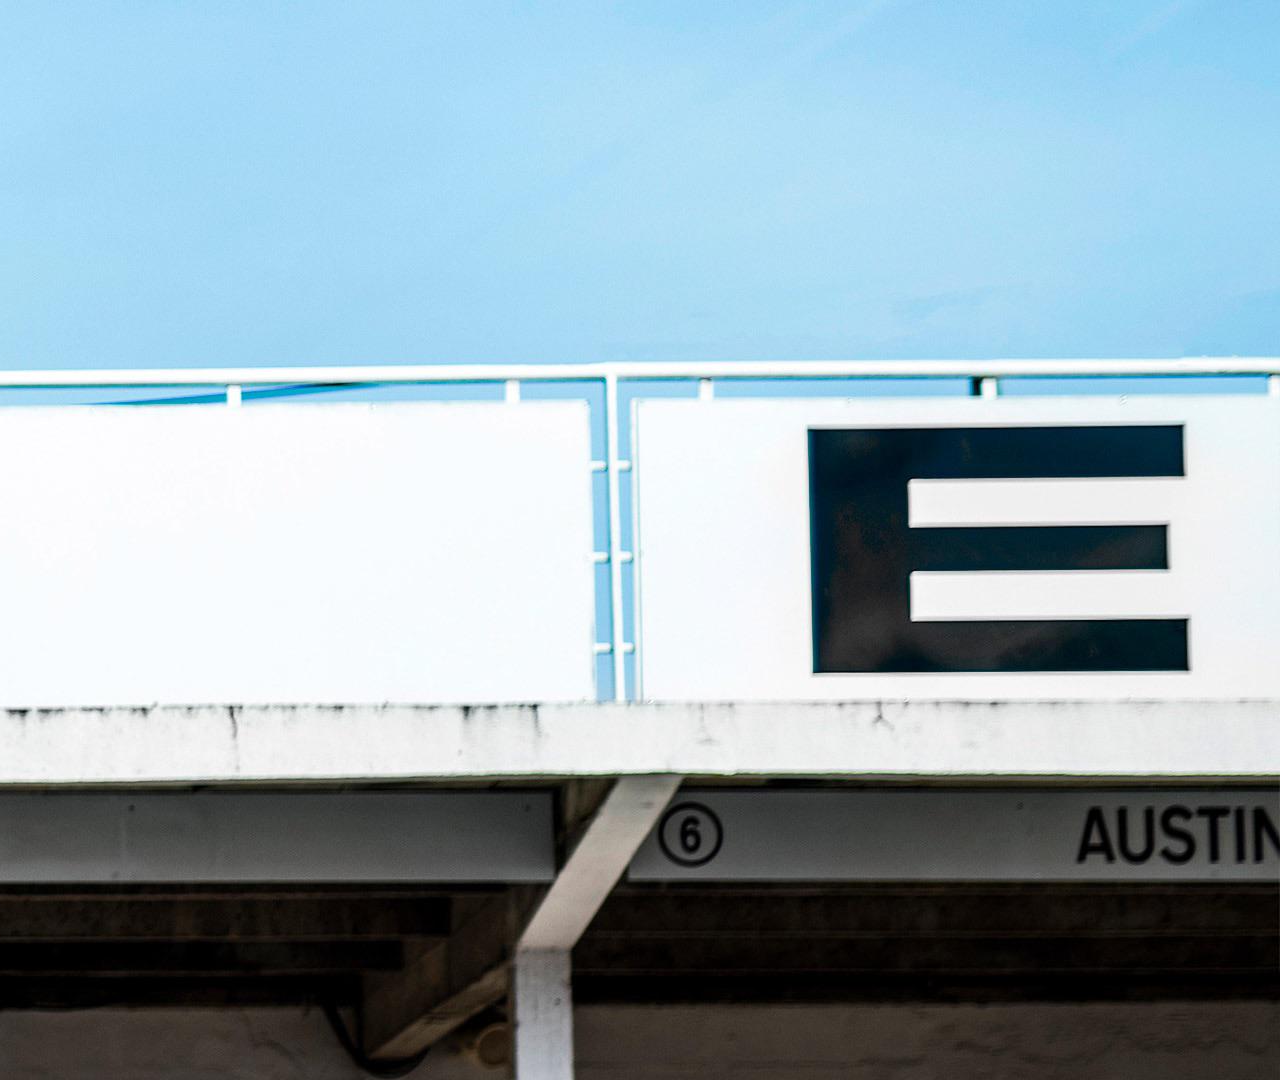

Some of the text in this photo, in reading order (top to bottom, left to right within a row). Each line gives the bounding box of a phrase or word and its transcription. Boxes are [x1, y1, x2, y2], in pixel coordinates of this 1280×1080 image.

[807, 424, 1190, 674] E
[677, 815, 703, 855] 6
[1076, 803, 1280, 866] AUSTIN
